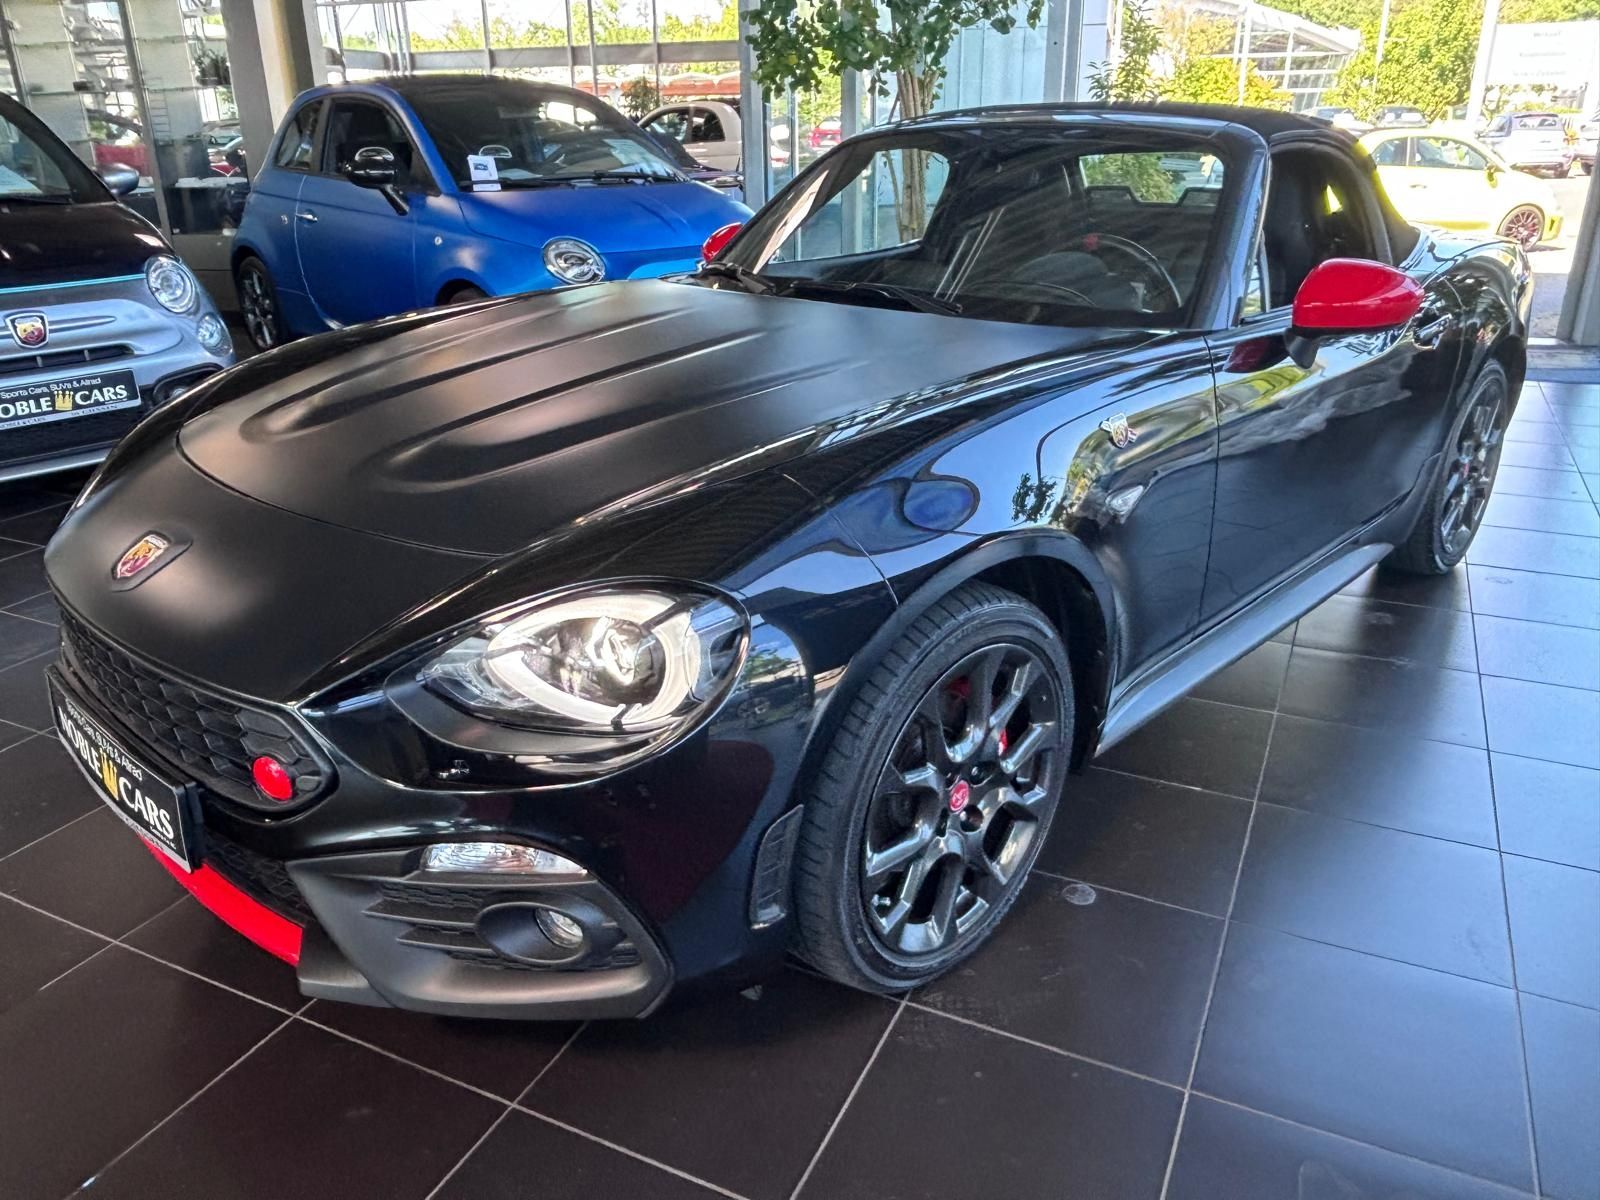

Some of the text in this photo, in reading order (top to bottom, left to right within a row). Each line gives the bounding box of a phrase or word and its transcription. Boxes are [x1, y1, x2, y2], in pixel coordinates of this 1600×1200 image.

[0, 388, 28, 399] Sports
[72, 380, 80, 388] &
[0, 397, 53, 418] OBLE
[74, 384, 128, 405] CARS
[58, 705, 103, 779] NOBLE
[118, 776, 174, 840] CARS
